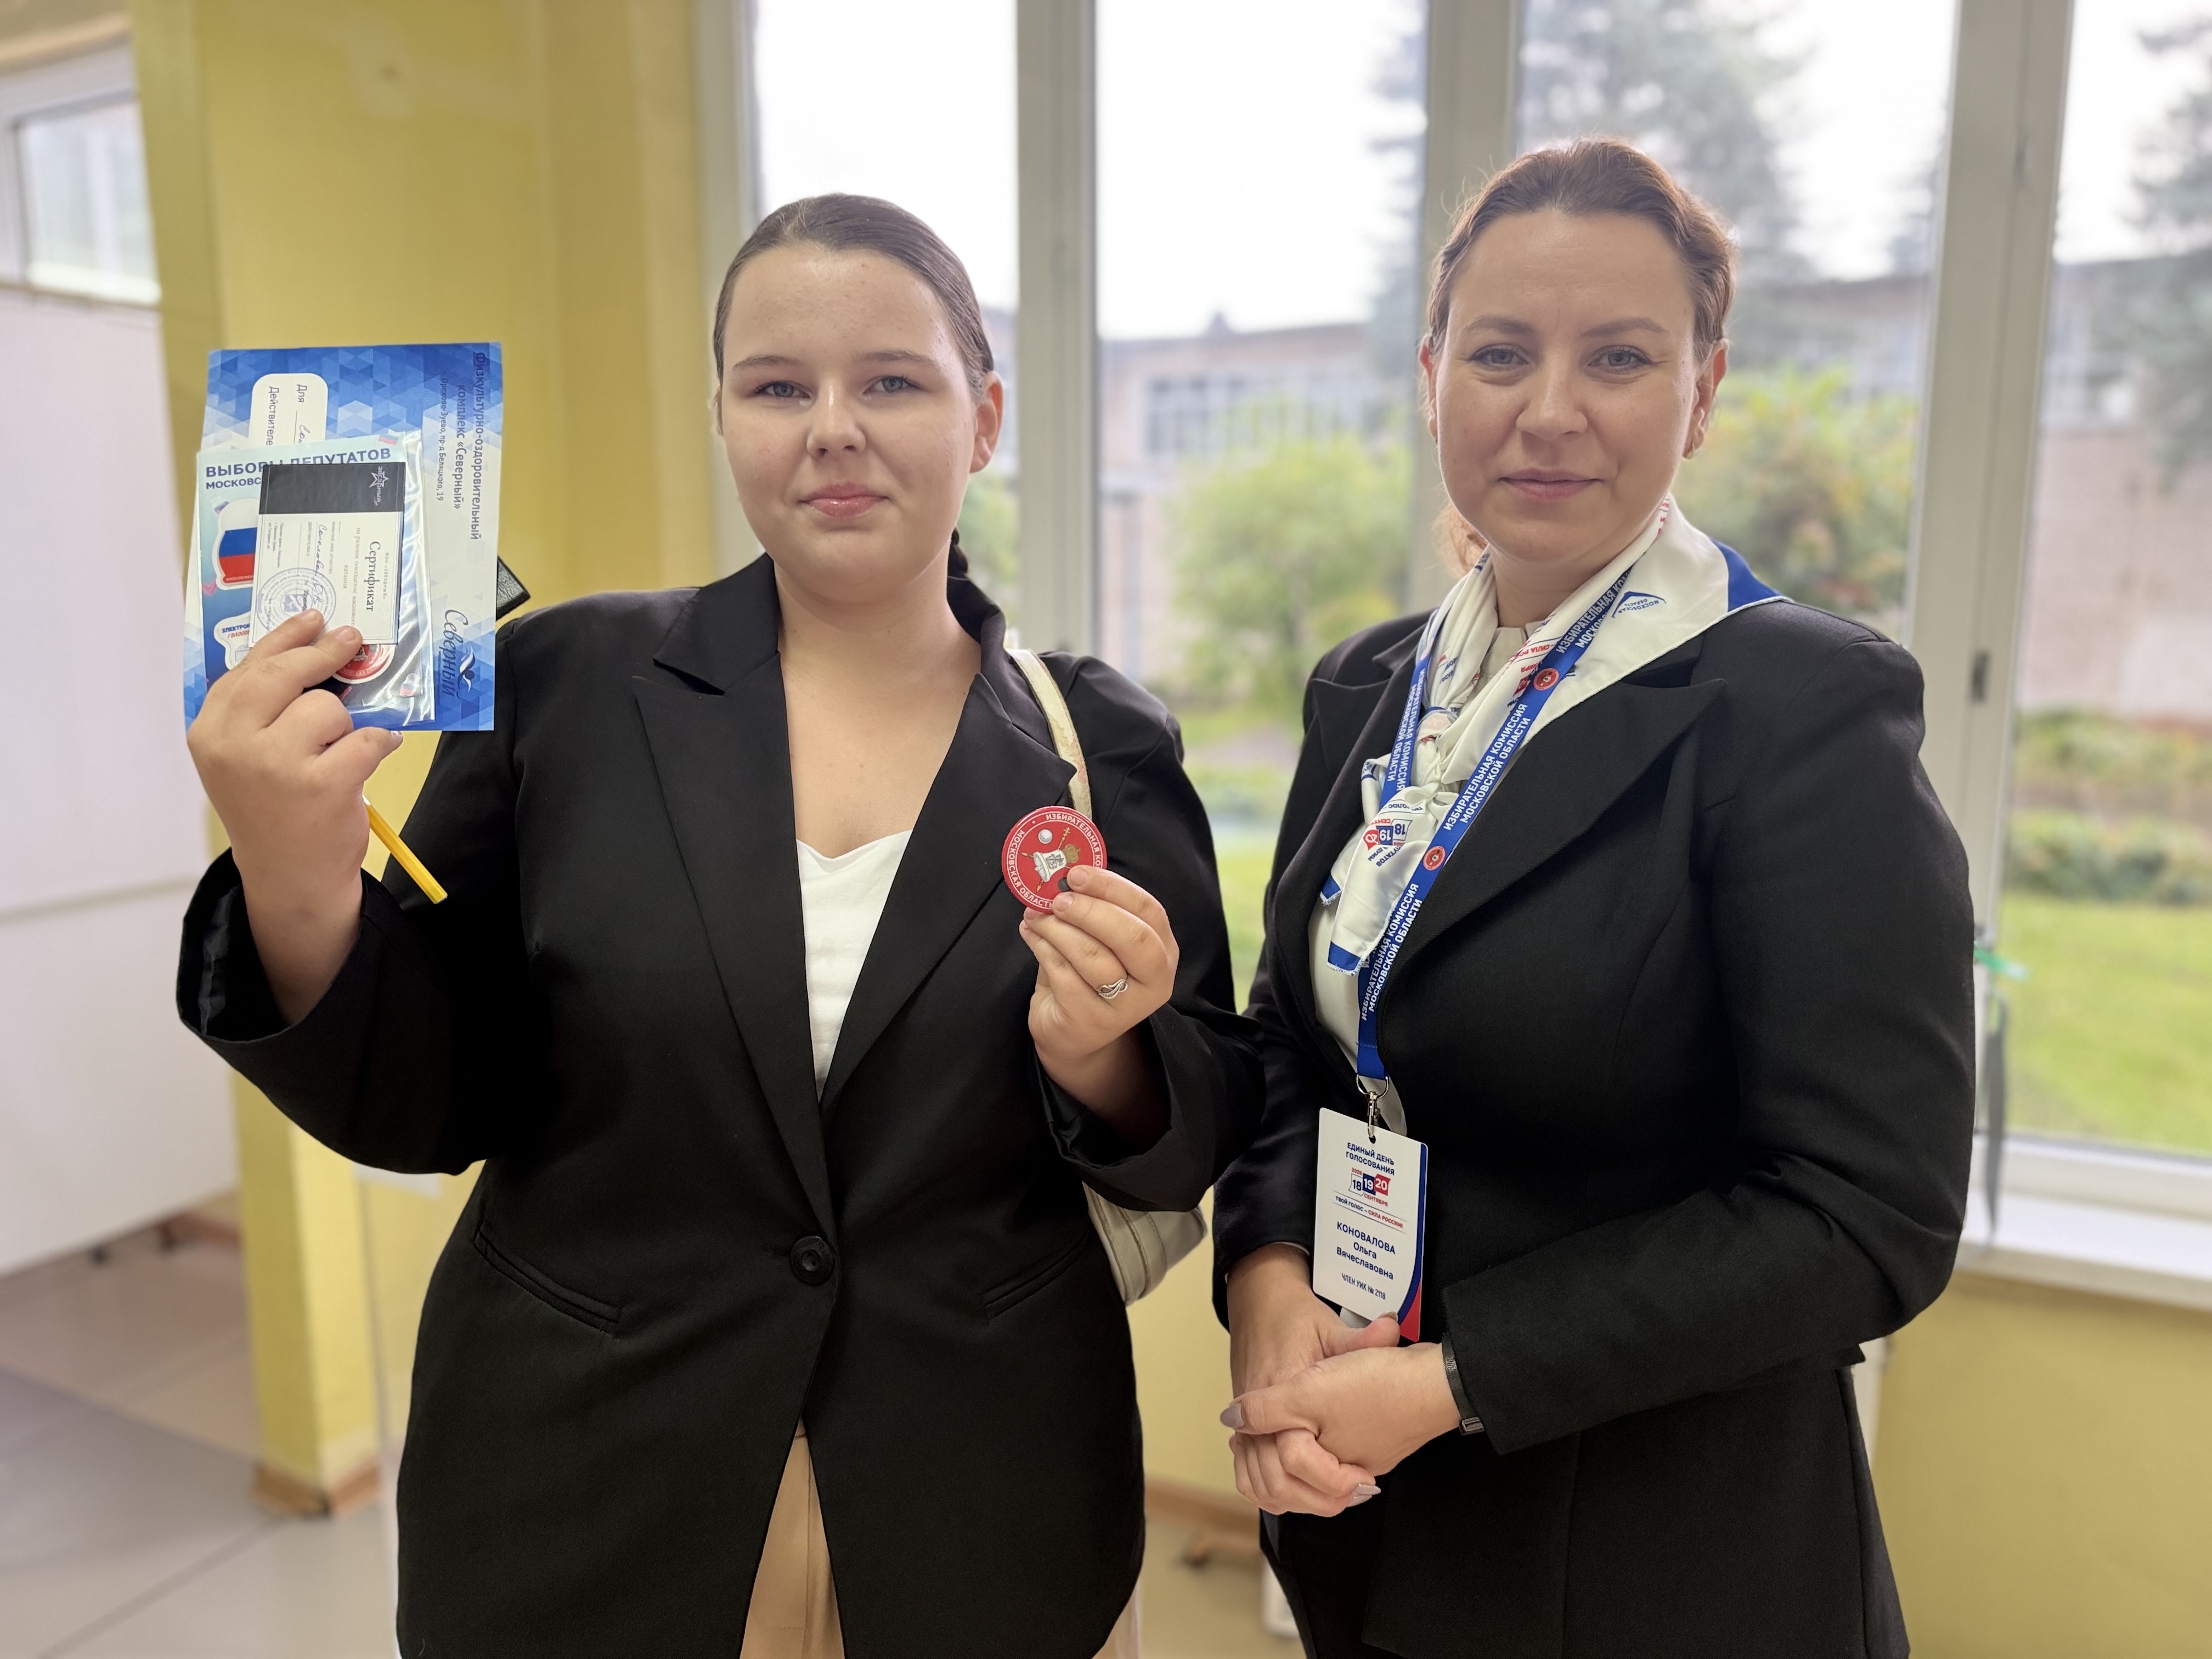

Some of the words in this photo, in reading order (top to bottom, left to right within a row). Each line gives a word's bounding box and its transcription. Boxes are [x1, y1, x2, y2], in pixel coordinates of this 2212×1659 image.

[296, 384, 308, 403] Для
[266, 386, 279, 445] Действителе
[456, 385, 466, 438] комплекс
[471, 352, 486, 539] Физкультурно-оздоровительный
[206, 460, 283, 477] ВЫБОР
[206, 477, 261, 489] МОСКОВС
[452, 442, 466, 509] «Северный»
[437, 492, 444, 501] 19
[364, 541, 381, 611] Сертификат
[1618, 600, 1659, 614] МОСКОВСКАЯ
[1624, 599, 1647, 607] ОБЛАСТЬ
[222, 623, 250, 633] ЭЛЕКТРОН
[228, 630, 250, 639] ГОЛОСО
[1556, 590, 1616, 653] ИЗБИРАТЕЛЬНАЯ
[439, 610, 469, 699] Северный
[1398, 684, 1417, 741] МОСКОВСКОЙ
[1406, 668, 1425, 739] ИЗБИРАТЕЛЬНАЯ
[1387, 742, 1403, 782] ОБЛАСТИ
[1396, 741, 1412, 791] КОМИССИЯ
[1443, 755, 1495, 831] ИЗБИРАТЕЛЬНАЯ
[1490, 703, 1528, 755] КОМИССИЯ
[1460, 760, 1504, 823] МОСКОВСКОЙ
[1499, 718, 1531, 759] ОБЛАСТИ
[1046, 814, 1101, 853] ИЗБИРАТЕЛЬНАЯ
[1365, 833, 1379, 845] 20
[1379, 830, 1391, 841] 19
[1395, 823, 1406, 836] 18
[1008, 830, 1025, 887] МОСКОВСКАЯ
[1019, 887, 1053, 907] ОБЛАСТЬ
[1361, 937, 1391, 1021] ИЗБИРАТЕЛЬНАЯ
[1386, 883, 1419, 937] КОМИССИЯ
[1368, 943, 1400, 1012] МОСКОВСКОЙ
[1395, 899, 1423, 943] ОБЛАСТИ
[1346, 1151, 1395, 1176] ГОЛОСОВАНИЯ
[1347, 1142, 1375, 1158] ЕДИНЫЙ
[1376, 1154, 1394, 1165] ДЕНЬ
[1352, 1180, 1362, 1191] 18
[1364, 1178, 1374, 1190] 19
[1375, 1178, 1387, 1190] 20
[1364, 1193, 1388, 1207] СЕНТЯБРЯ
[1335, 1196, 1347, 1204] ТВОЙ
[1348, 1201, 1364, 1211] ГОЛОС
[1368, 1210, 1381, 1220] СИЛА
[1337, 1221, 1396, 1255] КОНОВАЛОВА
[1353, 1242, 1377, 1259] Ольга
[1336, 1246, 1393, 1280] Вячеславовна
[1342, 1273, 1356, 1286] ЧЛЕН
[1357, 1279, 1367, 1291] УИК
[1368, 1285, 1374, 1294] №
[1375, 1289, 1386, 1300] 2118
